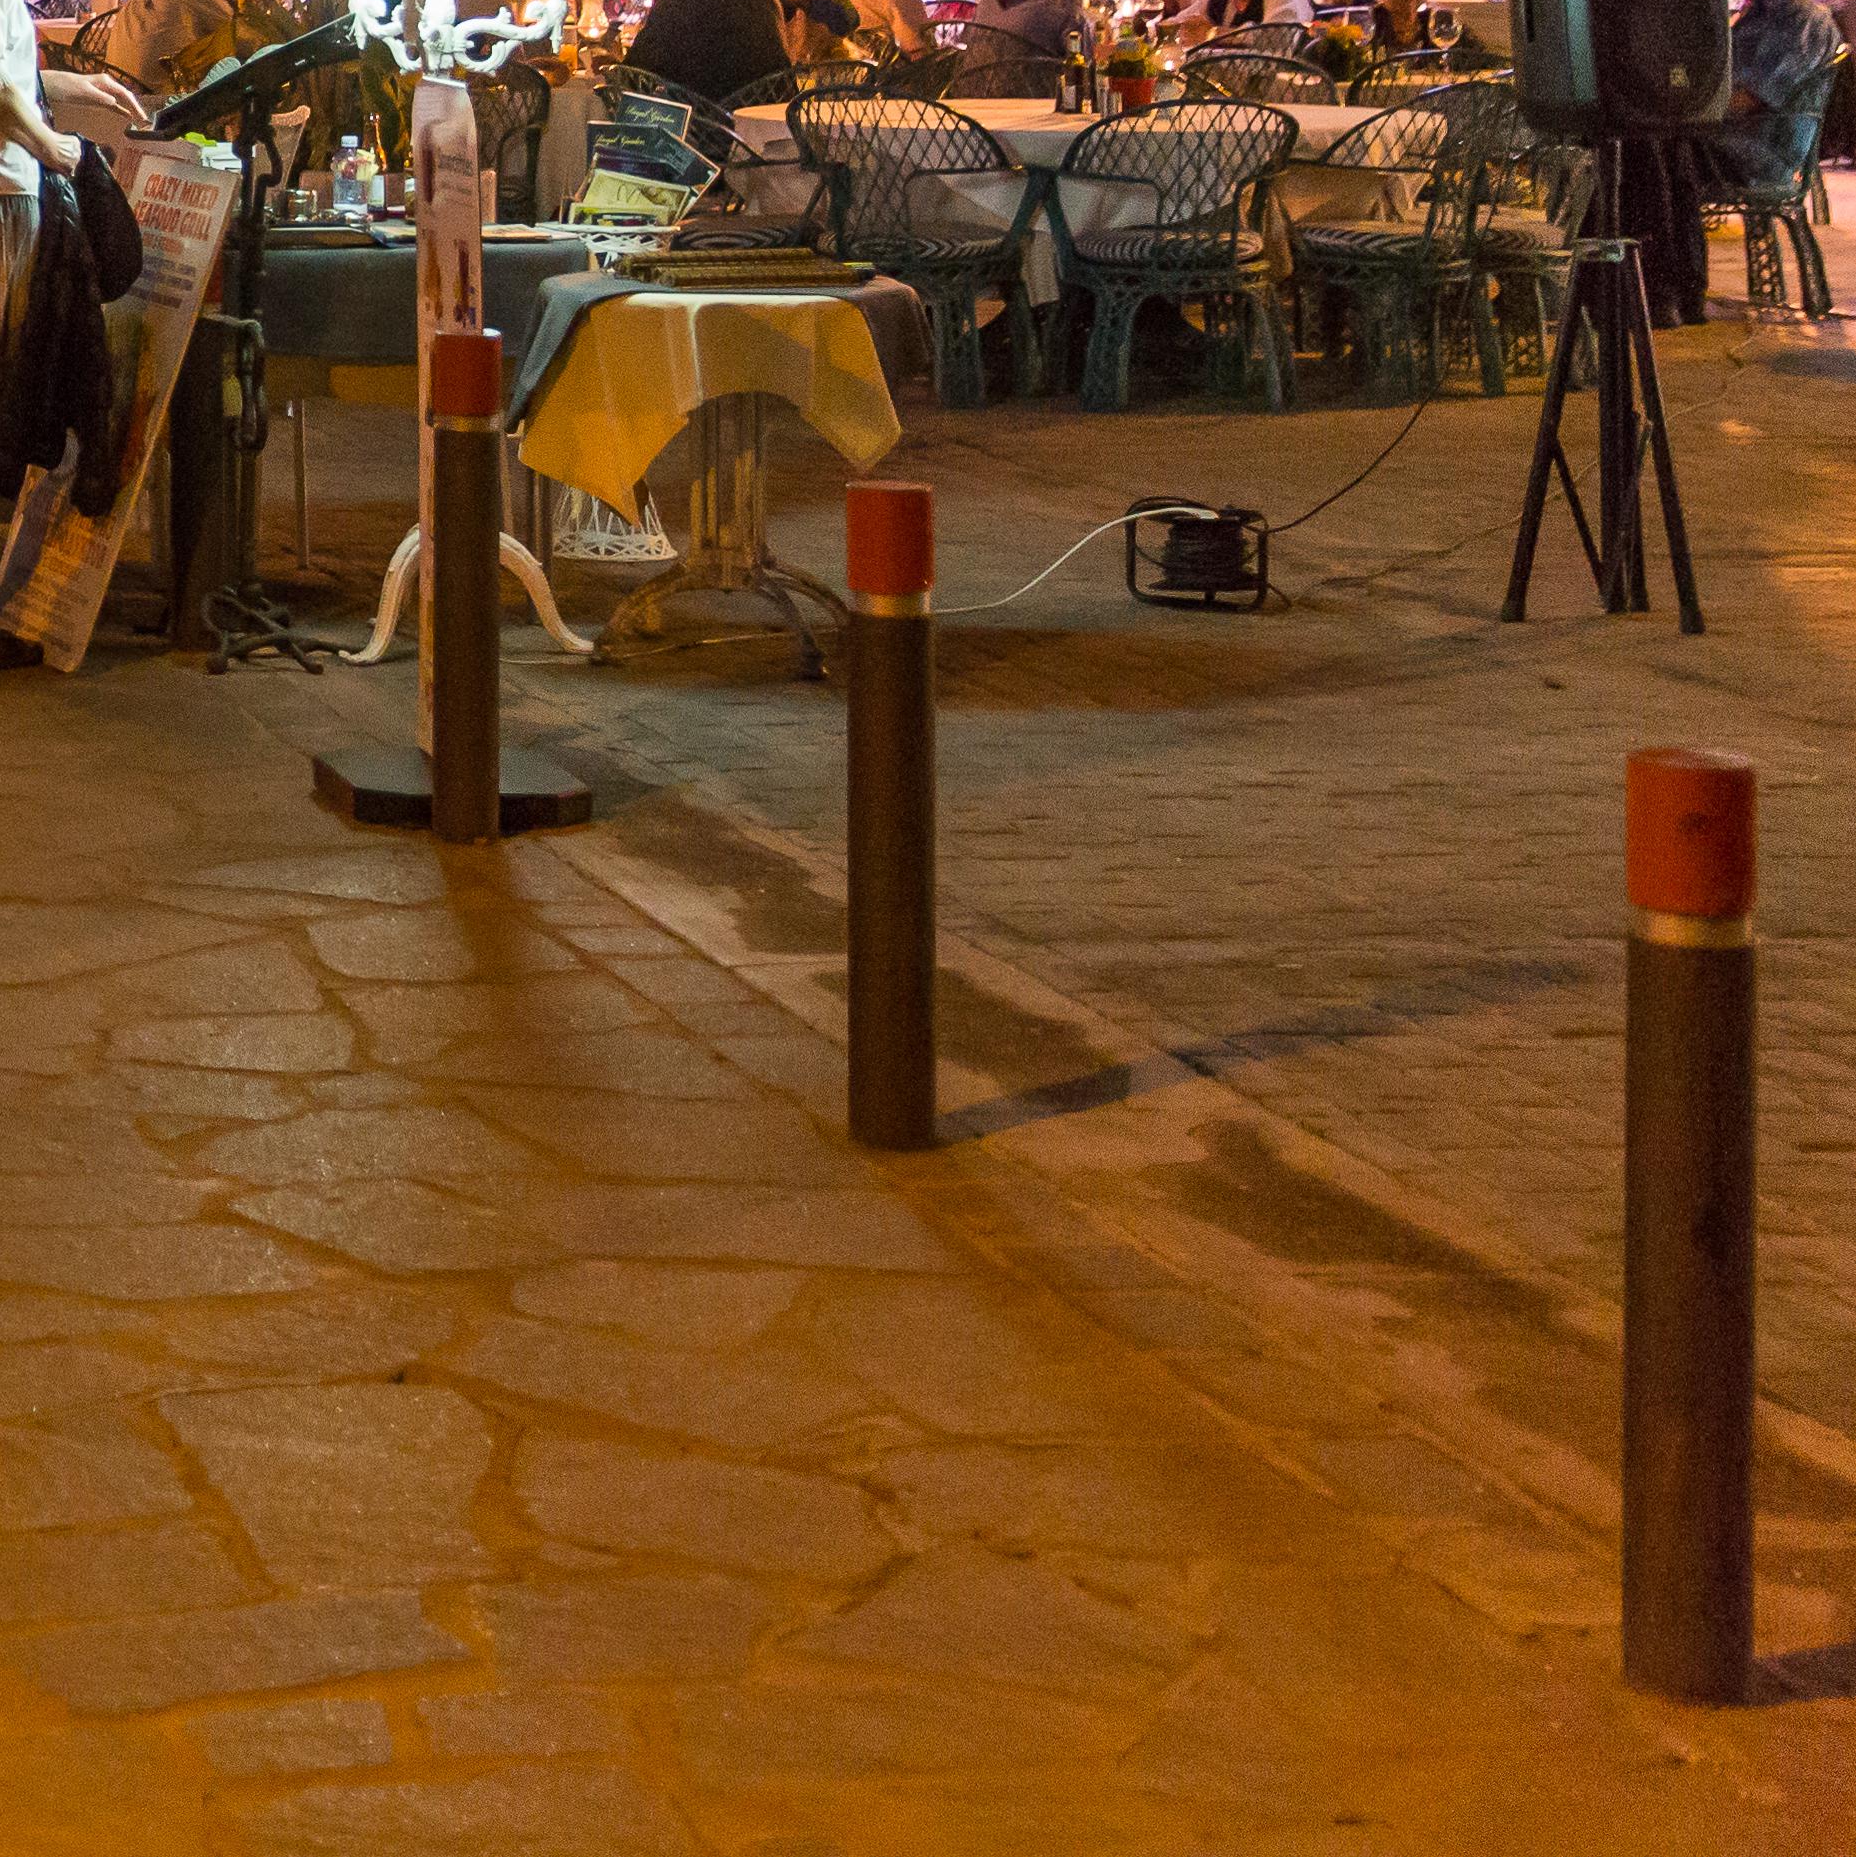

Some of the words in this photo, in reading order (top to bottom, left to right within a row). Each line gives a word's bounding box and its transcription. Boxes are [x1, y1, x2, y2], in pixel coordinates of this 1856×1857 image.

[144, 173, 180, 202] CRAZY
[179, 181, 219, 210] MIXED
[179, 211, 212, 241] GRILL
